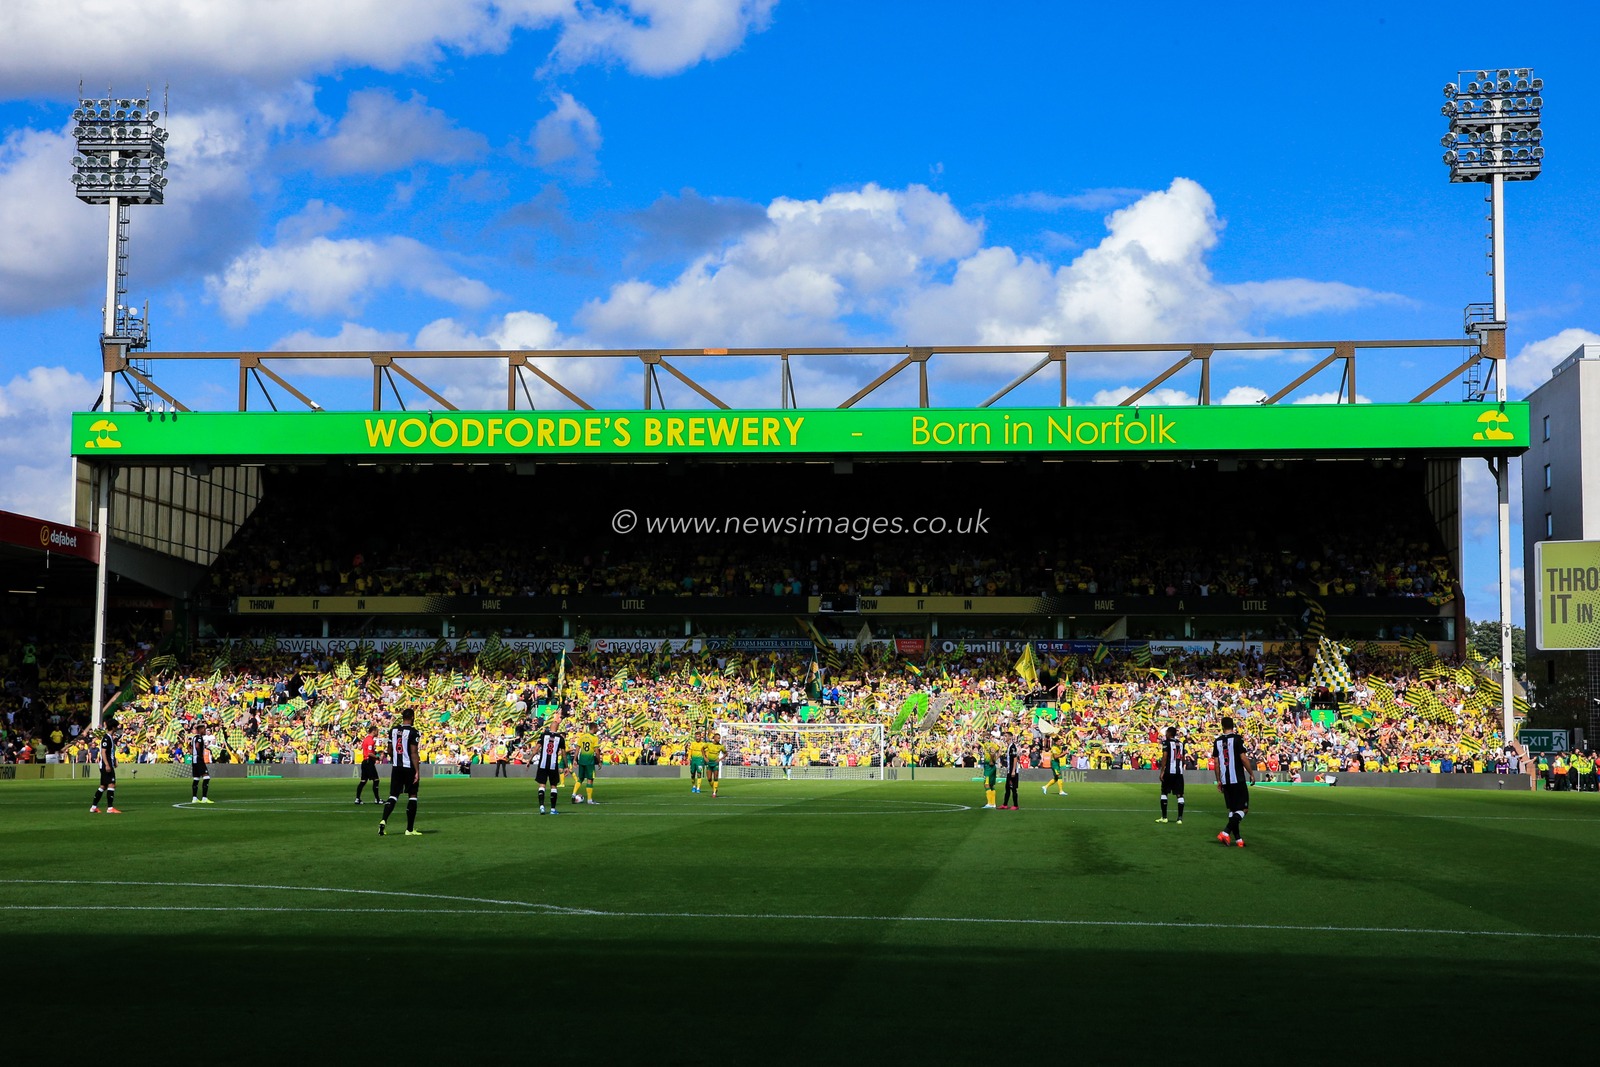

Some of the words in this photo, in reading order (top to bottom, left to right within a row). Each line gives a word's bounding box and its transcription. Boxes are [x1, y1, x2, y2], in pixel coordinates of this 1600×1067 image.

[364, 417, 631, 448] WOODFORDE'S
[645, 417, 805, 447] BREWERY
[912, 416, 991, 445] Born
[1004, 415, 1033, 445] in
[1047, 414, 1177, 445] Norfolk
[50, 530, 77, 547] dafabet
[1546, 567, 1600, 592] THRO
[250, 600, 275, 610] THROW
[313, 600, 320, 610] IT
[357, 600, 365, 610] IN
[482, 600, 501, 610] HAVE
[562, 600, 567, 610] A
[622, 600, 645, 610] LITTLE
[861, 600, 878, 610] ROW
[917, 600, 924, 610] IT
[964, 600, 972, 610] IN
[1095, 600, 1115, 610] HAVE
[1179, 601, 1185, 610] A
[1242, 600, 1267, 611] LITTLE
[1550, 594, 1572, 624] IT
[1577, 603, 1593, 624] IN
[271, 640, 322, 652] OSWELL
[381, 641, 438, 651] INSURANC
[513, 641, 565, 652] SERVICES
[608, 640, 657, 653] mayday
[396, 737, 404, 754] 6
[582, 741, 591, 752] 18
[1520, 736, 1549, 747] EXIT
[546, 742, 554, 755] 8
[40, 765, 46, 779] IT
[82, 765, 91, 778] IN
[246, 765, 272, 777] HAVE
[352, 766, 360, 778] A
[887, 768, 898, 780] IN
[1062, 771, 1088, 783] HAVE
